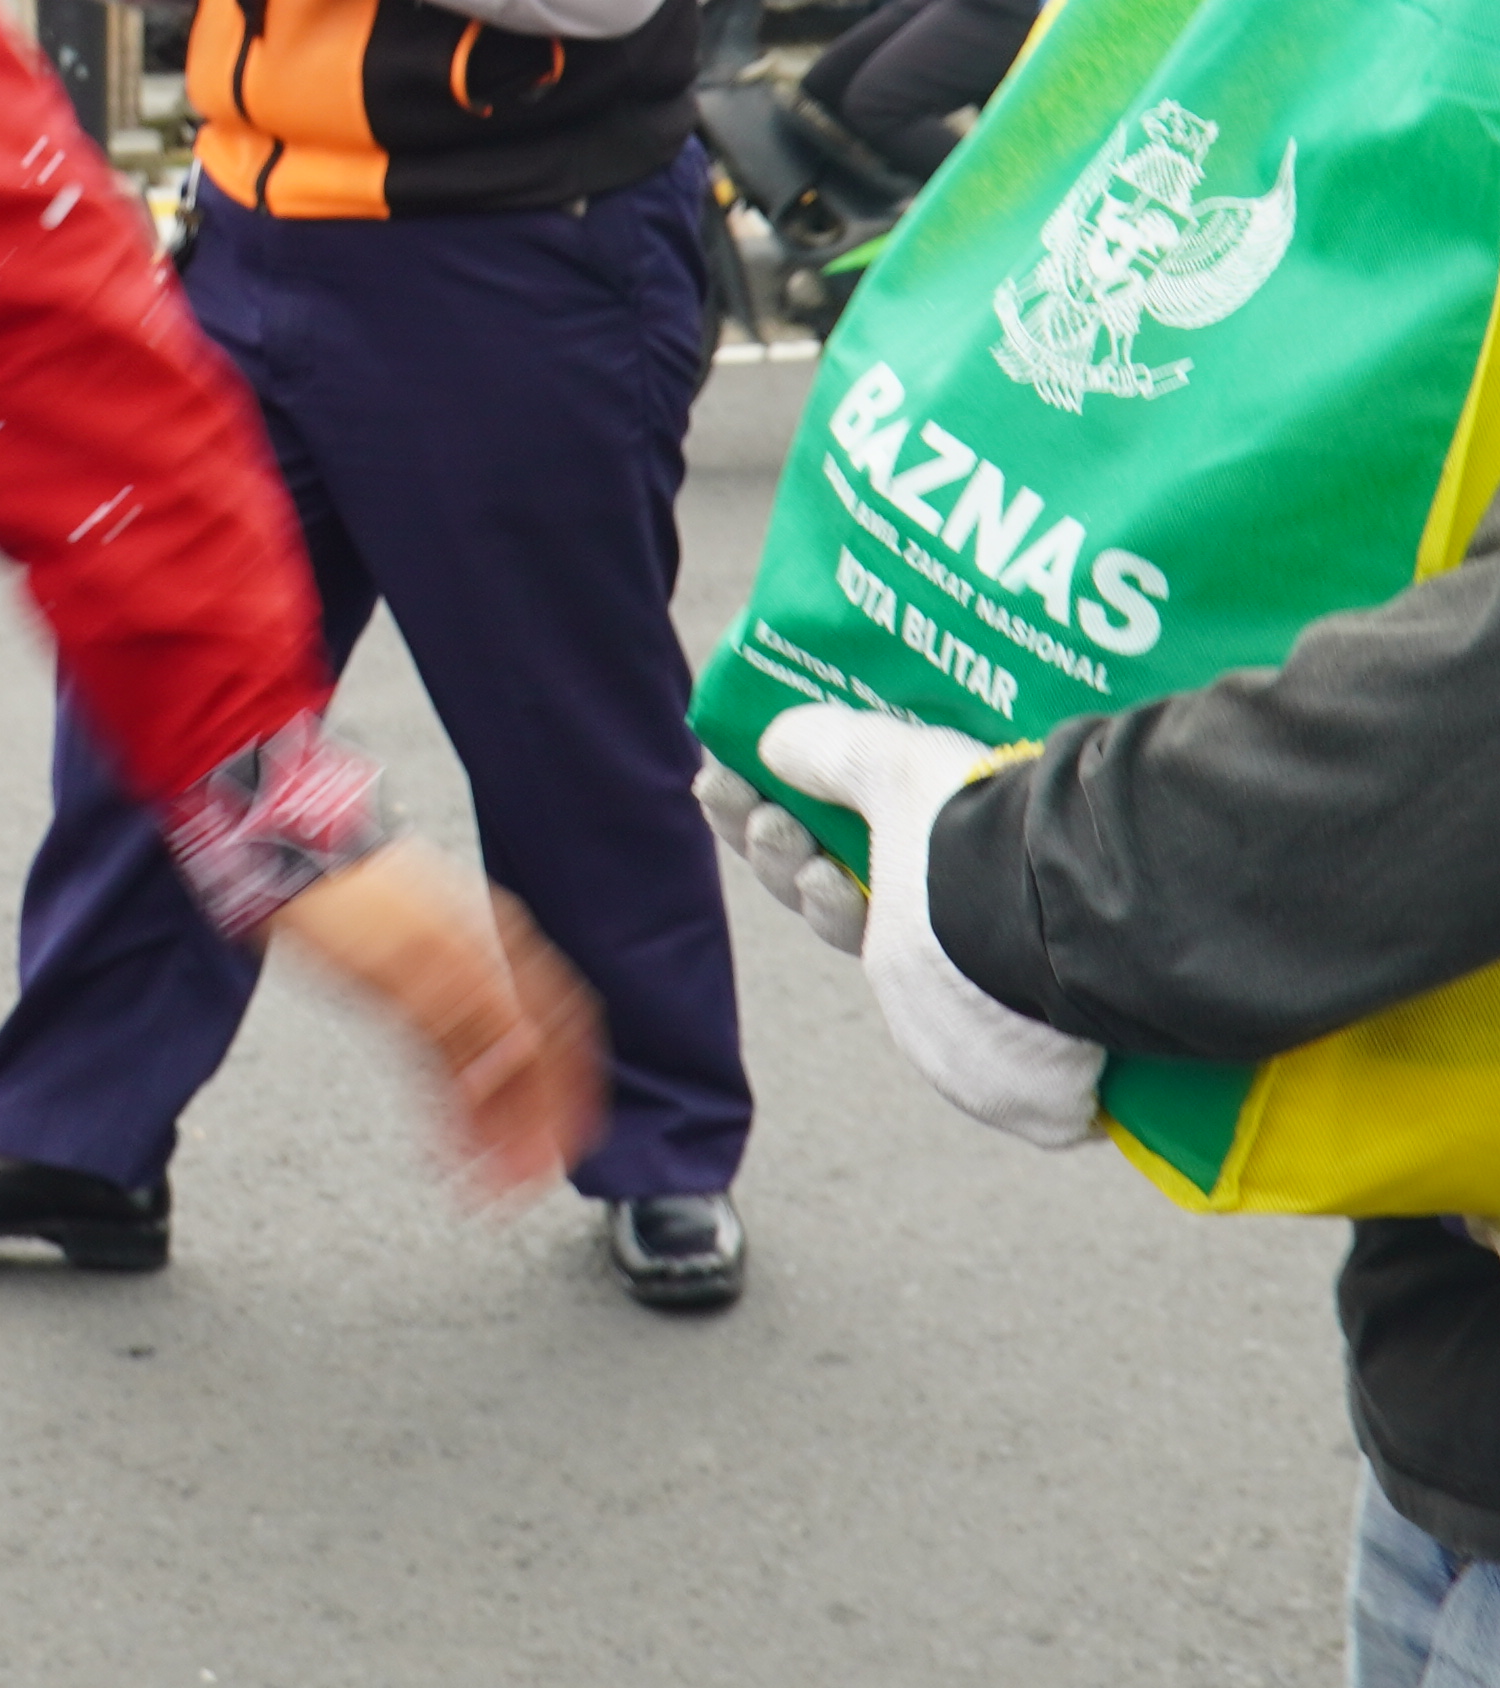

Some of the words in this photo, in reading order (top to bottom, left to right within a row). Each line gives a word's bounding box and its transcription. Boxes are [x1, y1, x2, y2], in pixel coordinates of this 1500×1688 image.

[828, 360, 1170, 657] BAZNAS
[901, 601, 1018, 722] BLITAR
[902, 536, 975, 609] ZAKAT
[975, 593, 1112, 696] NASIONAL
